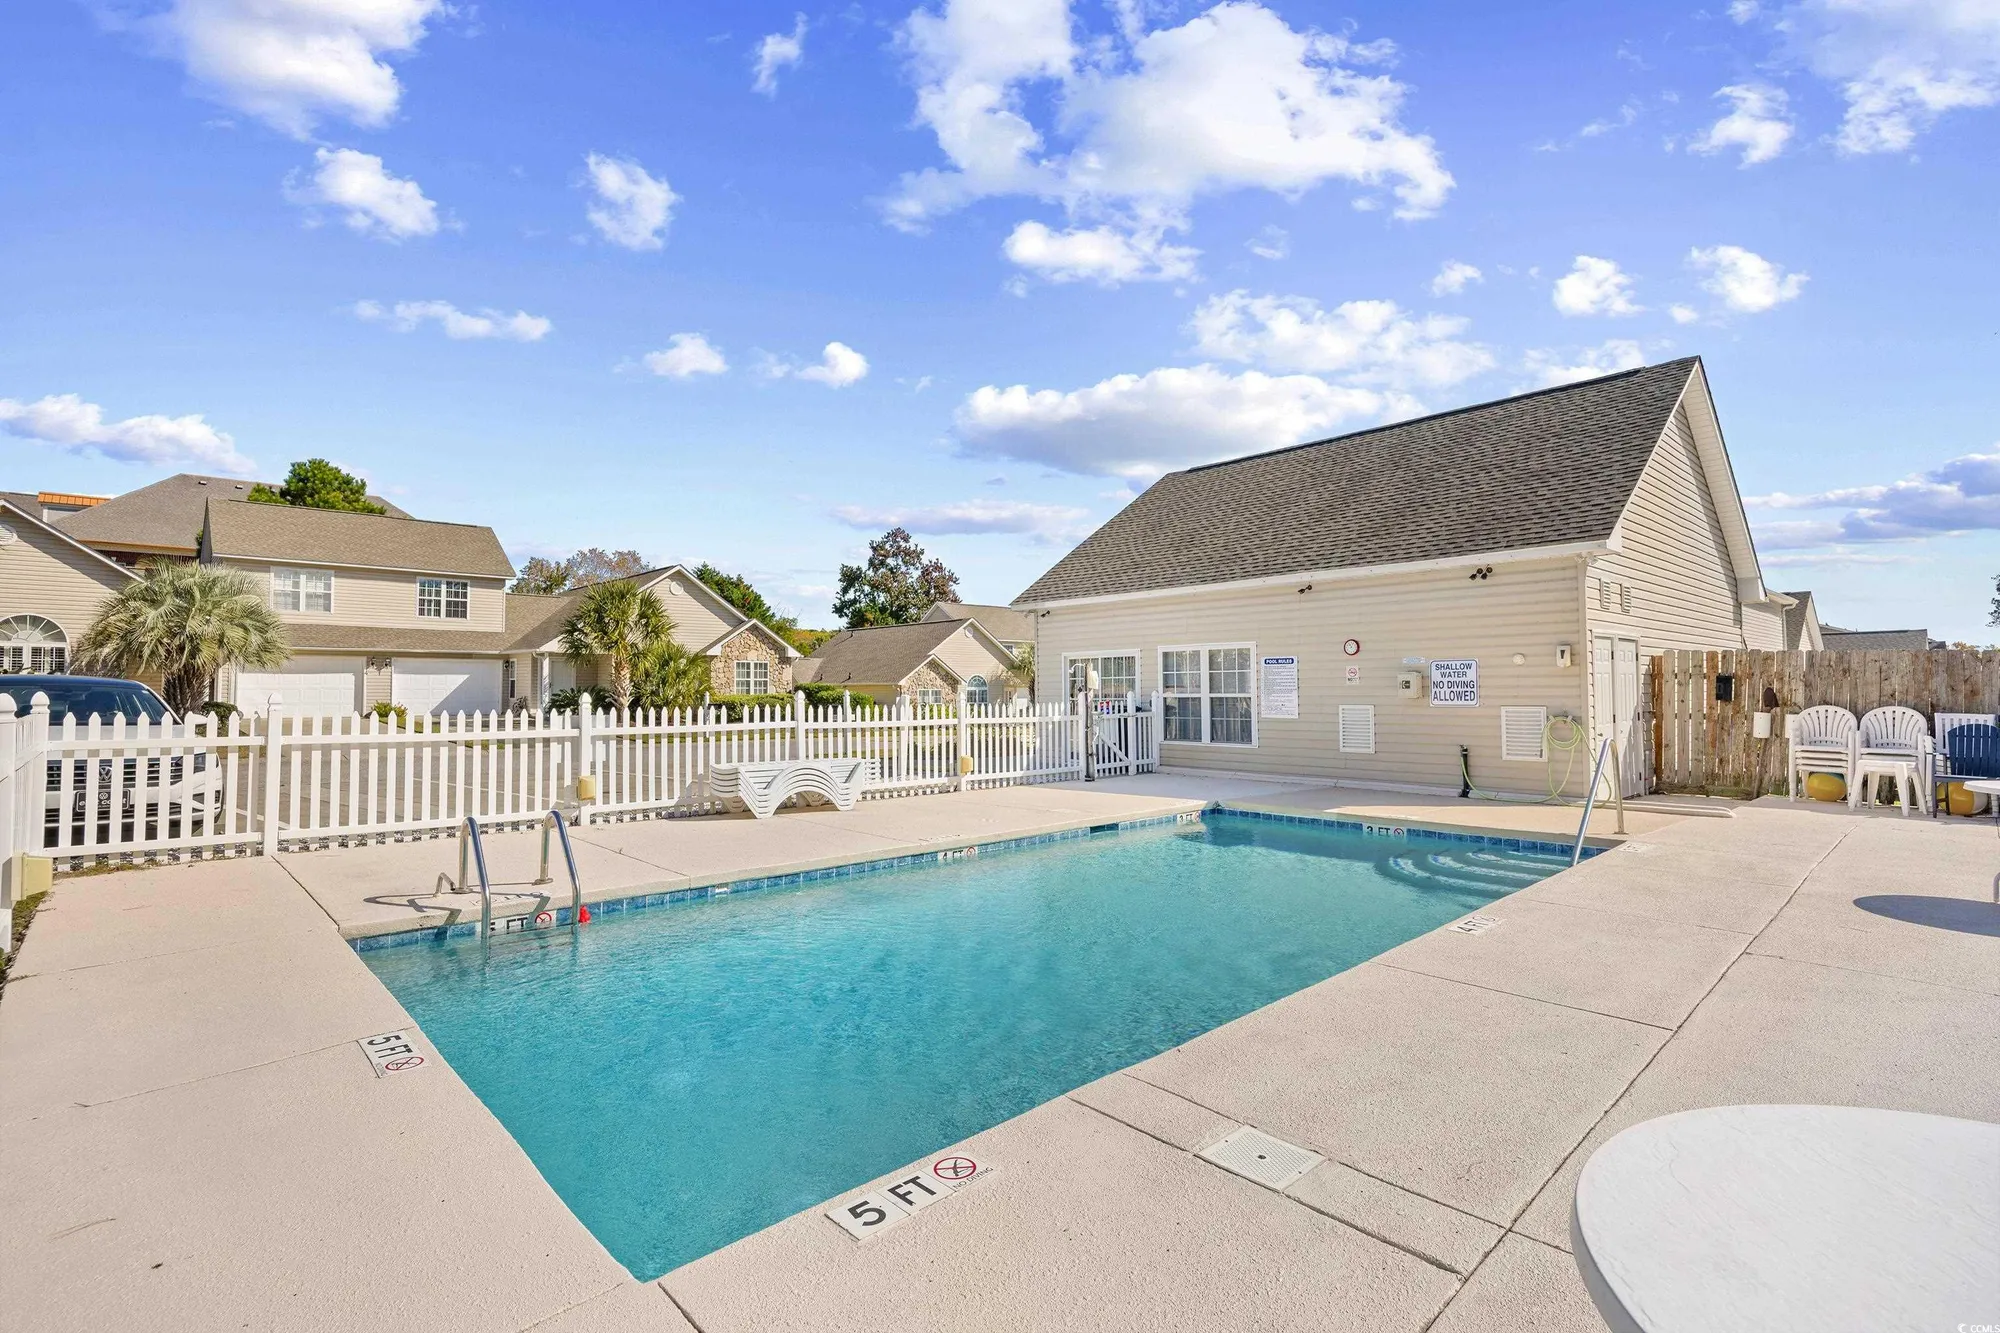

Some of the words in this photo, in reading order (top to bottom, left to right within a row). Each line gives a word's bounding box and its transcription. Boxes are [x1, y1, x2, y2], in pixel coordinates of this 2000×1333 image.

[1435, 662, 1473, 671] SHALLOW
[1440, 670, 1468, 679] WATER
[1432, 680, 1445, 689] NO
[1447, 680, 1475, 689] DIVING
[1432, 690, 1476, 701] ALLOWED
[367, 1034, 402, 1046] 5
[374, 1043, 414, 1059] FT
[953, 1180, 967, 1190] NO
[966, 1166, 994, 1182] DIVING
[847, 1200, 887, 1227] 5
[887, 1175, 937, 1206] FT
